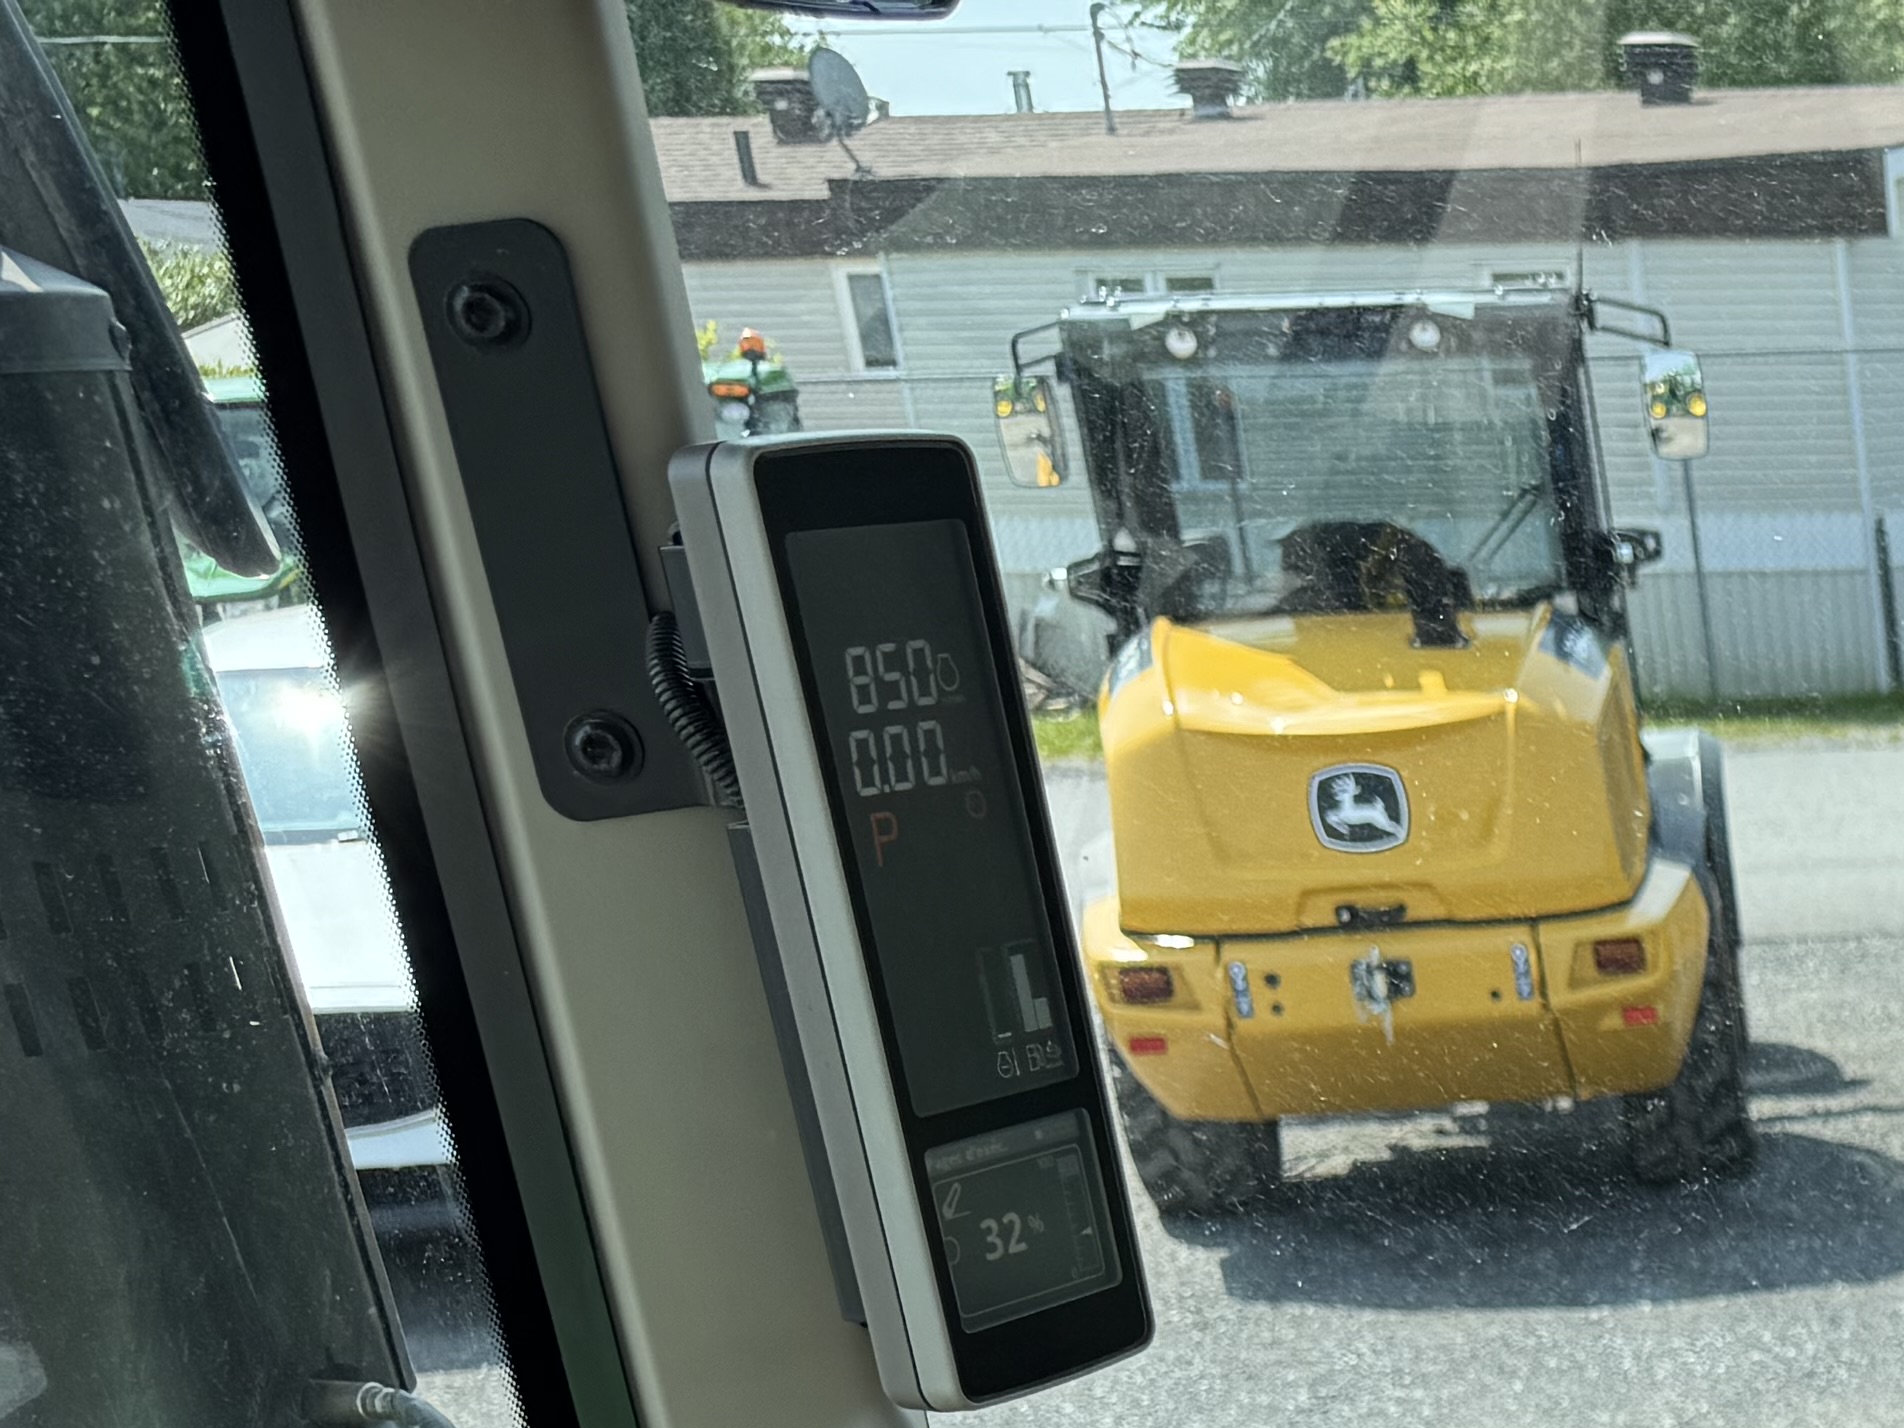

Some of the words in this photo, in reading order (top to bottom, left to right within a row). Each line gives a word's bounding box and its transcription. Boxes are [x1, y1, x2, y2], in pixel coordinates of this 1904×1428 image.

[845, 639, 938, 714] 850
[849, 720, 949, 797] 0.00
[870, 811, 899, 867] P
[979, 1211, 1028, 1261] 32
